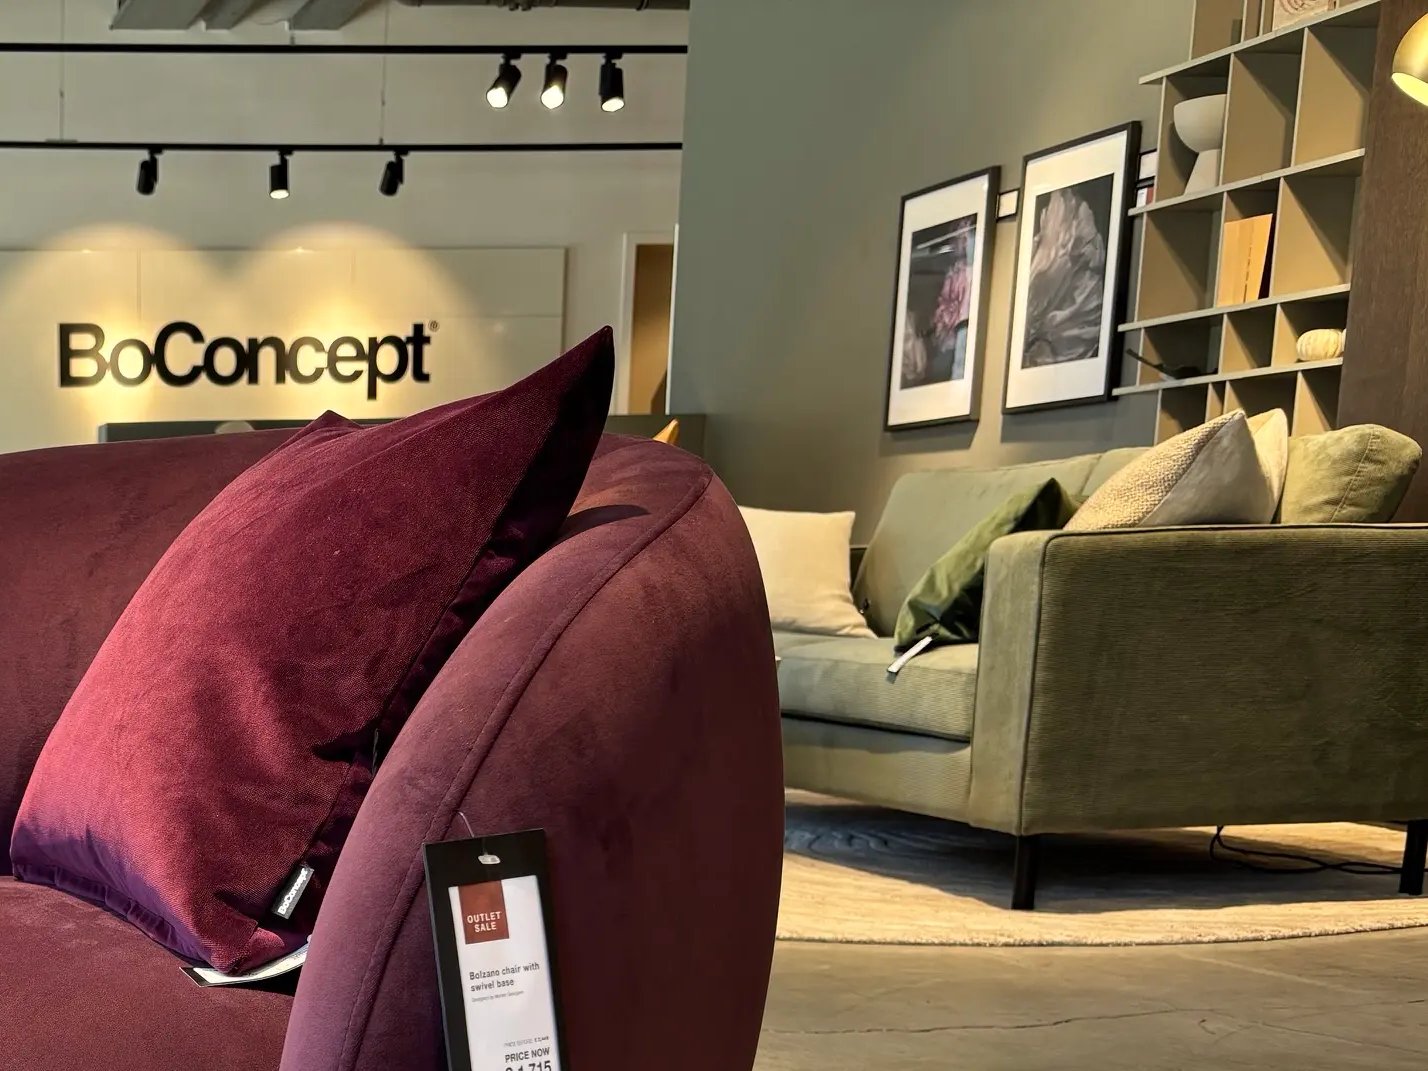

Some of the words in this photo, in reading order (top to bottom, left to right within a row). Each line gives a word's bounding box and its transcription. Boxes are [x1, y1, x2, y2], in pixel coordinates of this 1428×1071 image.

[59, 321, 432, 401] BoConcept
[277, 867, 308, 915] BoConcept
[466, 911, 502, 924] OUTLET
[474, 921, 498, 933] SALE
[469, 968, 500, 981] Bolzano
[501, 964, 521, 976] chair
[522, 961, 540, 973] with
[470, 980, 495, 992] swivel
[496, 978, 515, 989] base
[504, 1050, 530, 1063] PRICE
[531, 1046, 551, 1058] NOW
